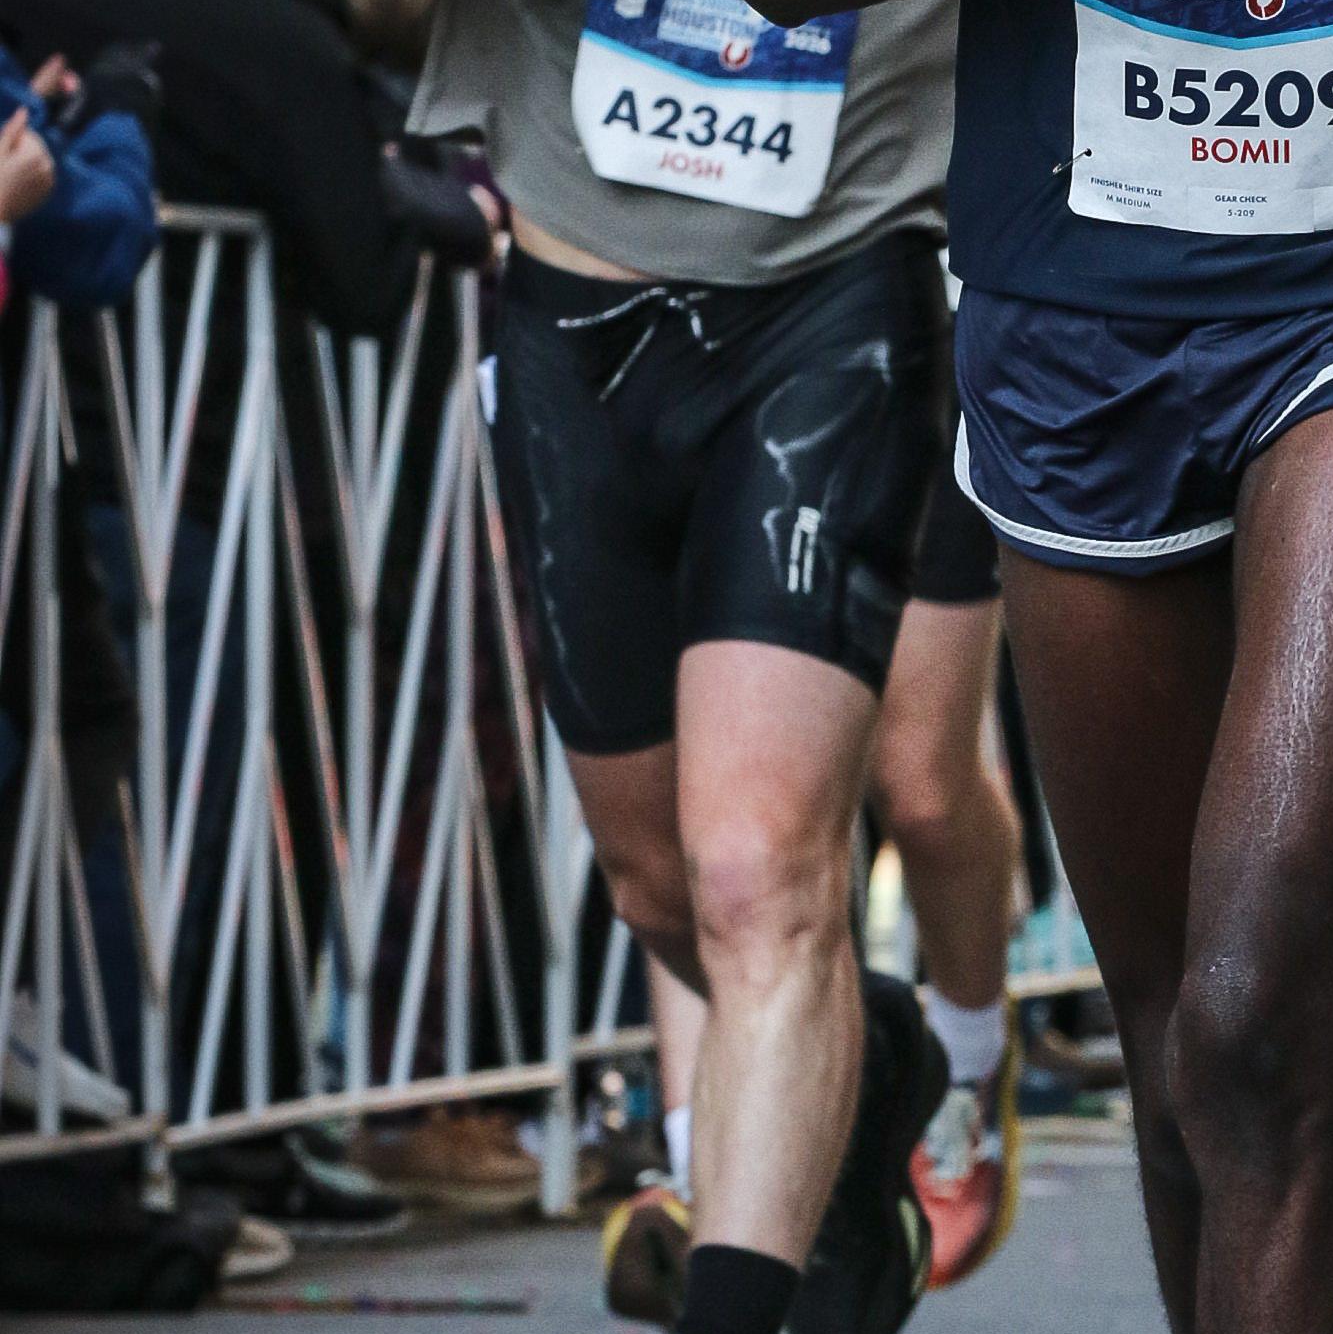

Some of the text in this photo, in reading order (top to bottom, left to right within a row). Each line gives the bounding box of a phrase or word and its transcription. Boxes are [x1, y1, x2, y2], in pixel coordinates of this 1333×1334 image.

[603, 89, 793, 164] A2344
[1191, 136, 1291, 165] BOMII
[659, 153, 725, 181] JOSH
[1090, 177, 1163, 197] FINISHER SHIRT SIZE
[1215, 194, 1268, 203] GEAR CHECK
[1106, 194, 1151, 209] M MEDIUM
